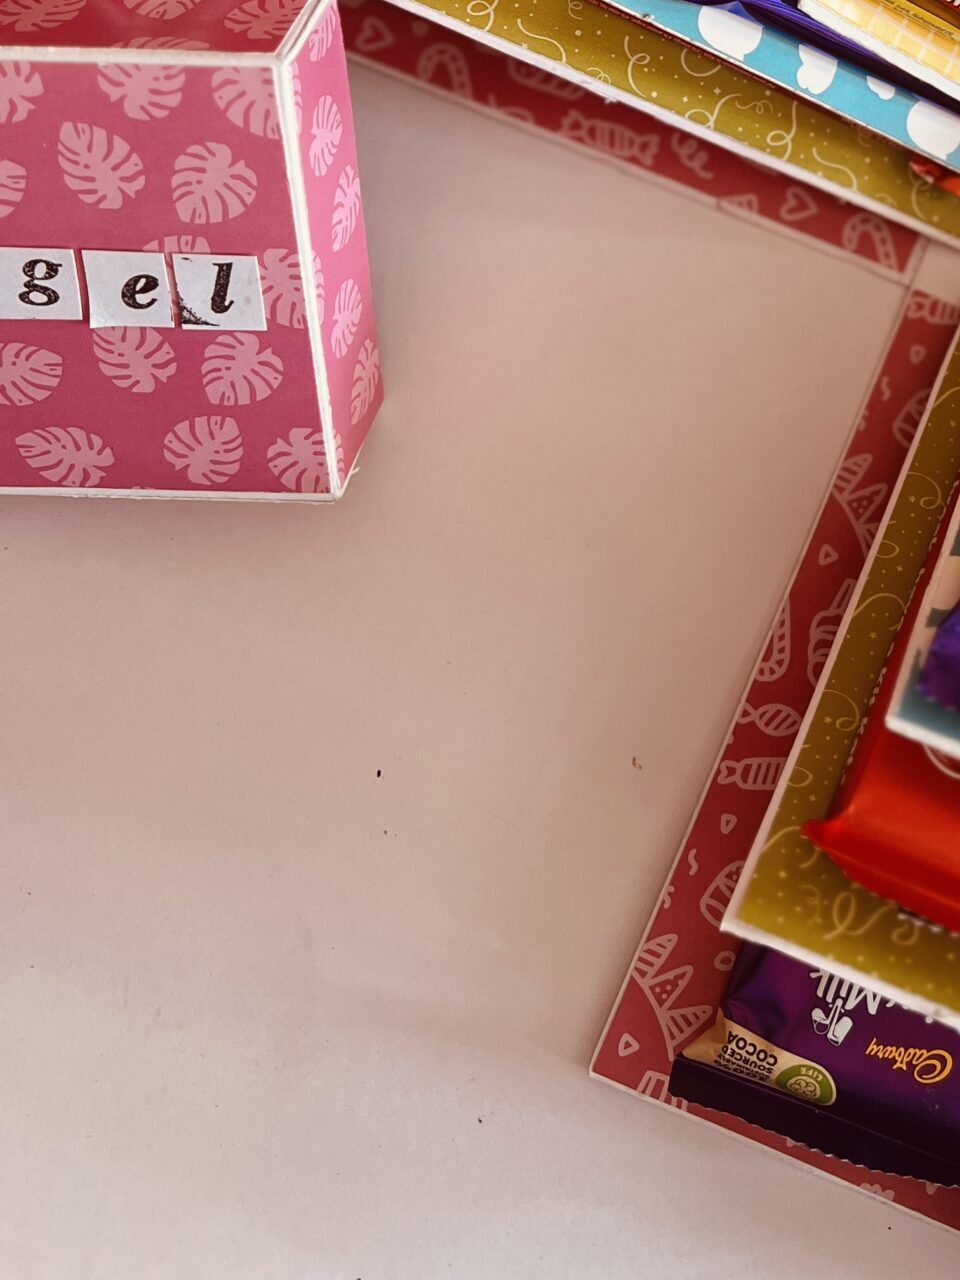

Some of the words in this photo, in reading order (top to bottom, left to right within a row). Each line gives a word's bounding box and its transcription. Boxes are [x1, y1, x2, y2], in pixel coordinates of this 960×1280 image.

[721, 1043, 775, 1075] SOURCED
[727, 1029, 778, 1067] COCOA
[865, 1037, 953, 1084] Cadbury
[800, 1066, 824, 1082] LIFE
